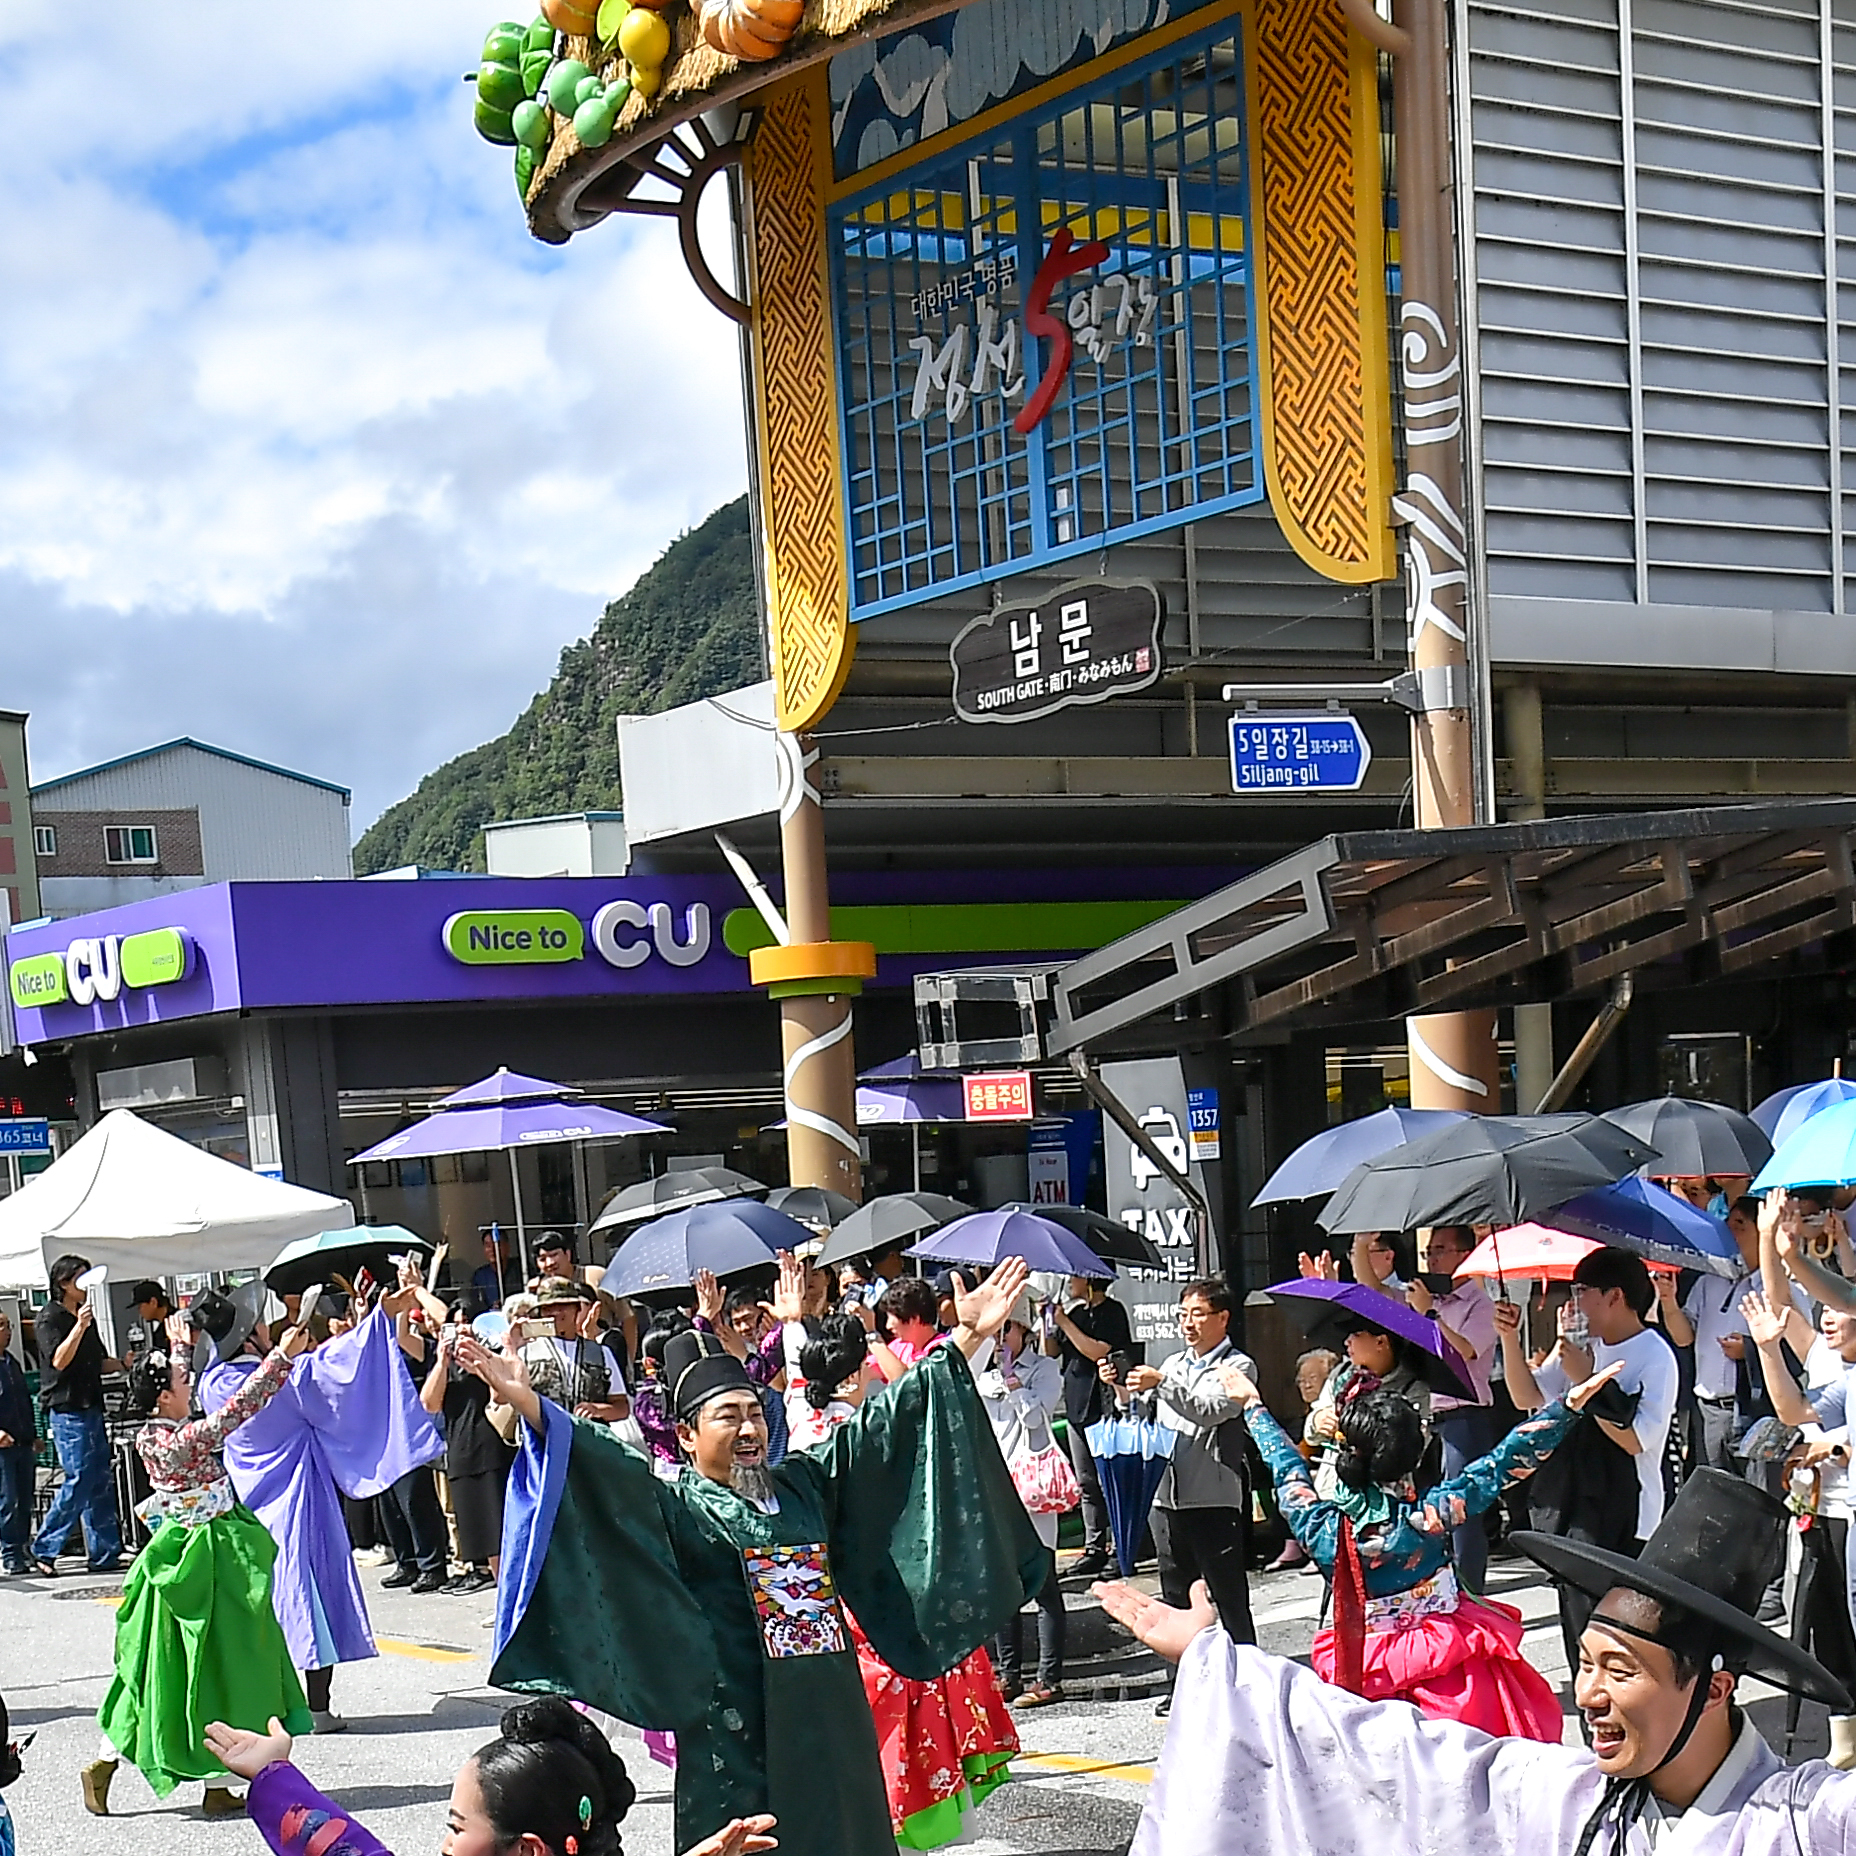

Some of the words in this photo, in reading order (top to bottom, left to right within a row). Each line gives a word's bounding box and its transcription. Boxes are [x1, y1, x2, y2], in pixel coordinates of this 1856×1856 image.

[911, 273, 976, 320] 대한민국
[981, 254, 1015, 295] 명품
[1010, 599, 1092, 678] 남문
[977, 688, 1015, 710] SOUTH
[1238, 726, 1309, 760] 5일장길
[1241, 763, 1320, 786] 5iljang-gil
[469, 925, 532, 951] Nice
[538, 925, 567, 949] to
[592, 900, 711, 968] CU
[17, 971, 43, 996] Nice
[43, 970, 56, 991] to
[66, 934, 120, 1005] CU
[970, 1083, 1026, 1111] 충돌주의
[1191, 1109, 1218, 1128] 1357
[1033, 1180, 1066, 1204] ATM
[1120, 1208, 1194, 1246] TAX
